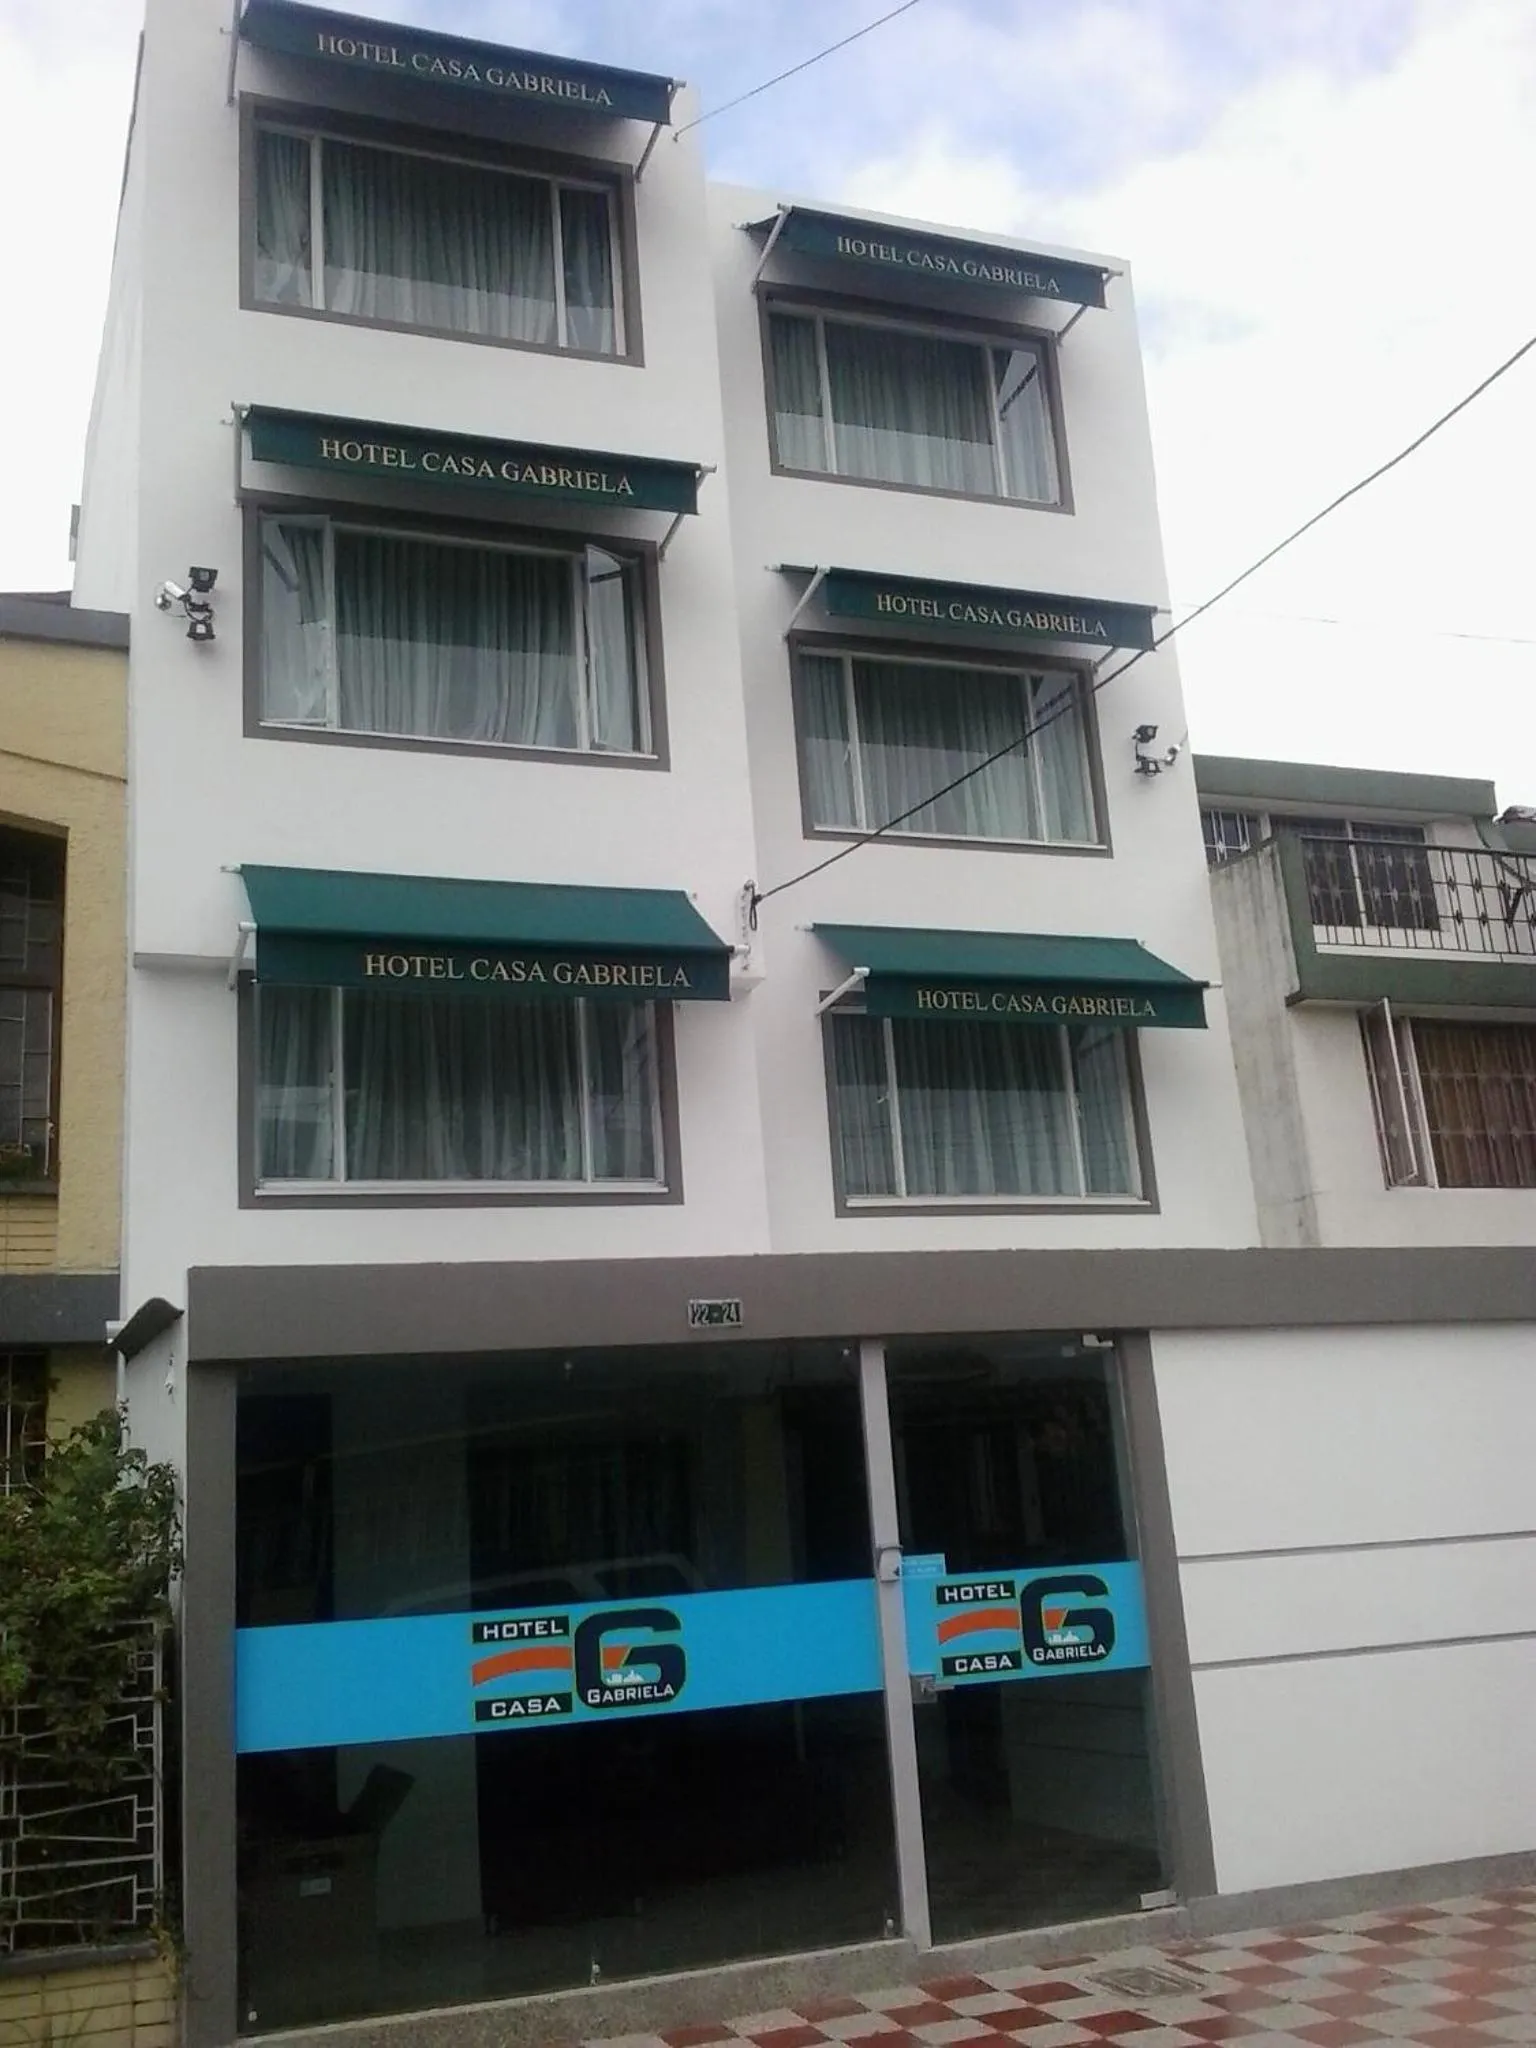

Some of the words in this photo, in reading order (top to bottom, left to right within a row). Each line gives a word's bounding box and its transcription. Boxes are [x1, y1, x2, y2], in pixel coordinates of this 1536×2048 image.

[317, 33, 405, 68] HOTEL
[411, 53, 480, 82] CASA
[486, 67, 613, 106] GABRIELA
[836, 236, 903, 264] HOTEL
[906, 250, 960, 275] CASA
[963, 259, 1060, 294] GABRIELA
[320, 438, 416, 469] HOTEL
[421, 452, 495, 479] CASA
[501, 461, 634, 495] GABRIELA
[877, 594, 945, 619] HOTEL
[949, 603, 1004, 626] CASA
[1007, 610, 1107, 637] GABRIELA
[365, 954, 464, 980] HOTEL
[470, 959, 547, 983] CASA
[553, 963, 691, 988] GABRIELA
[917, 990, 989, 1011] HOTEL
[992, 993, 1050, 1014] CASA
[1052, 996, 1157, 1018] GABRIELA
[944, 1583, 1012, 1602] HOTEL
[482, 1620, 564, 1641] HOTEL
[1032, 1644, 1107, 1662] GABRIELA
[954, 1658, 1013, 1673] CASA
[587, 1684, 675, 1704] GABRIELA
[491, 1698, 562, 1717] CASA
